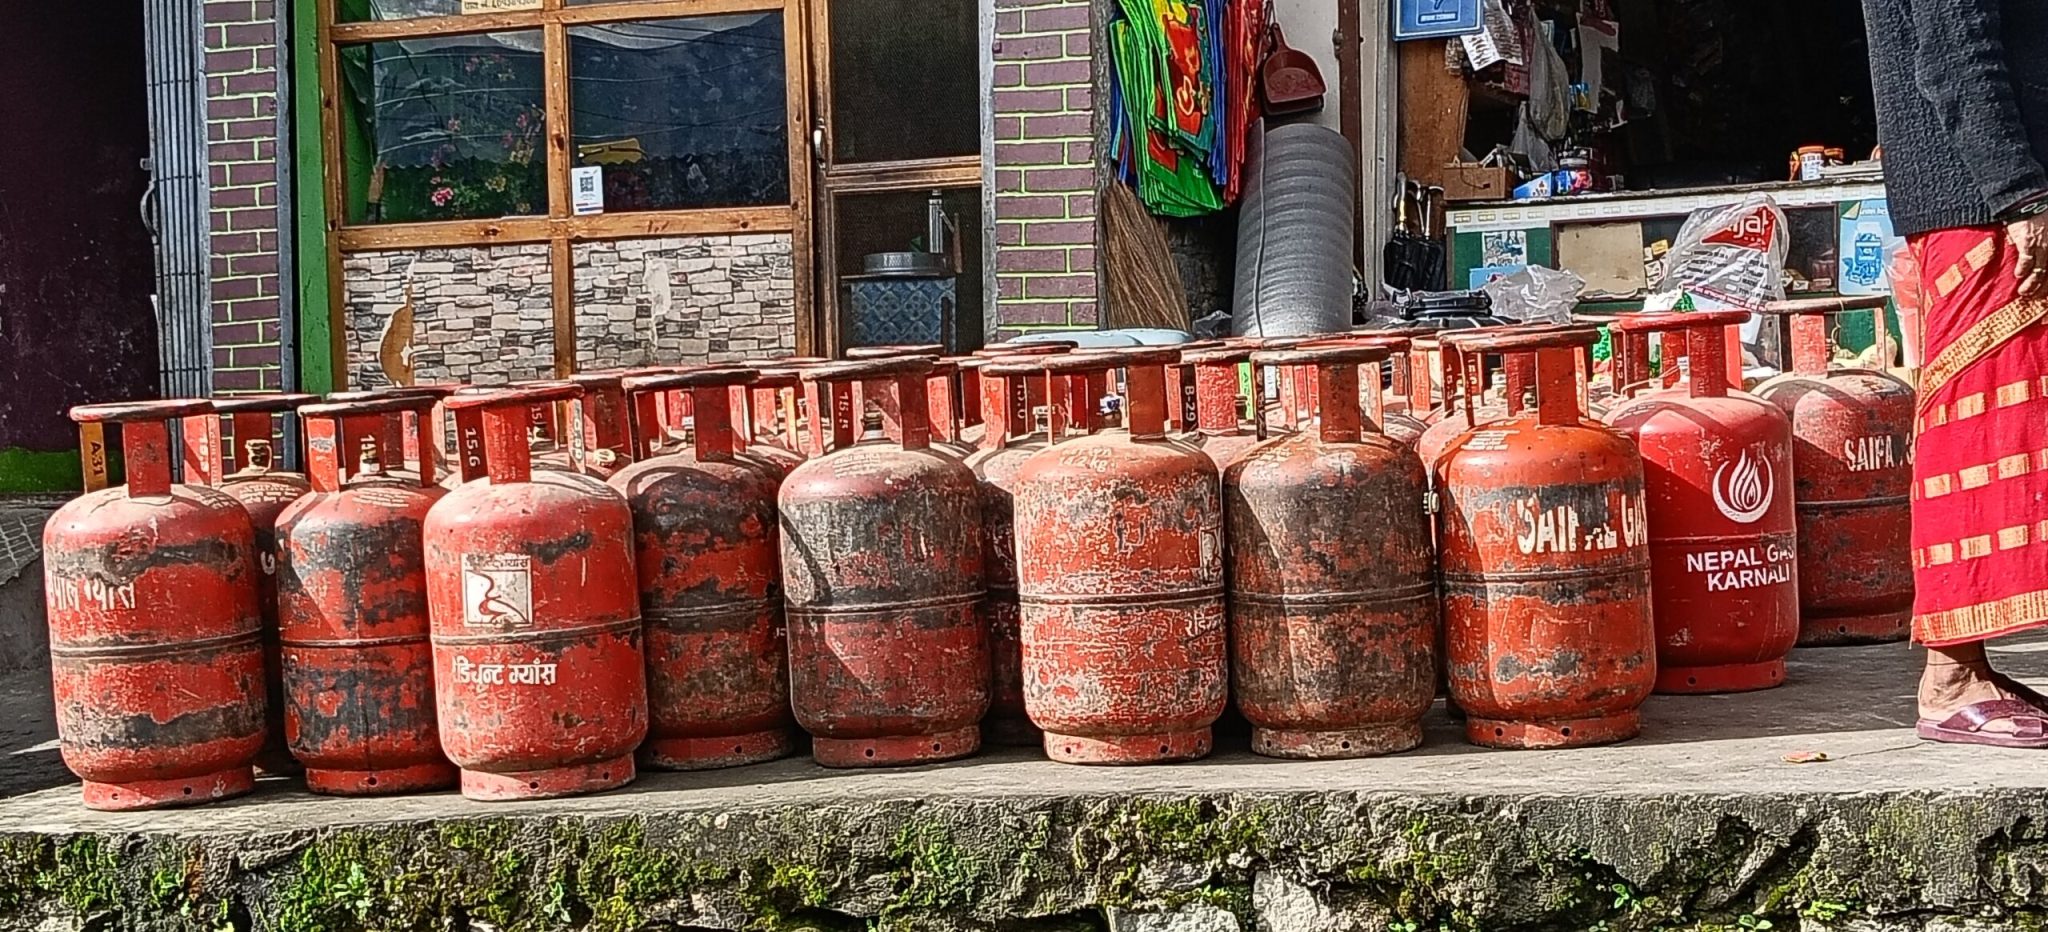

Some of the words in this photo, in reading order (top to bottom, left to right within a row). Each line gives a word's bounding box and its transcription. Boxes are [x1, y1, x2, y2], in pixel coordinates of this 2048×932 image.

[1184, 385, 1196, 422] B-29
[464, 427, 481, 468] 15.6
[1844, 434, 1904, 472] SAIPA
[1686, 546, 1763, 573] NEPAL
[1707, 562, 1791, 593] KARNALI
